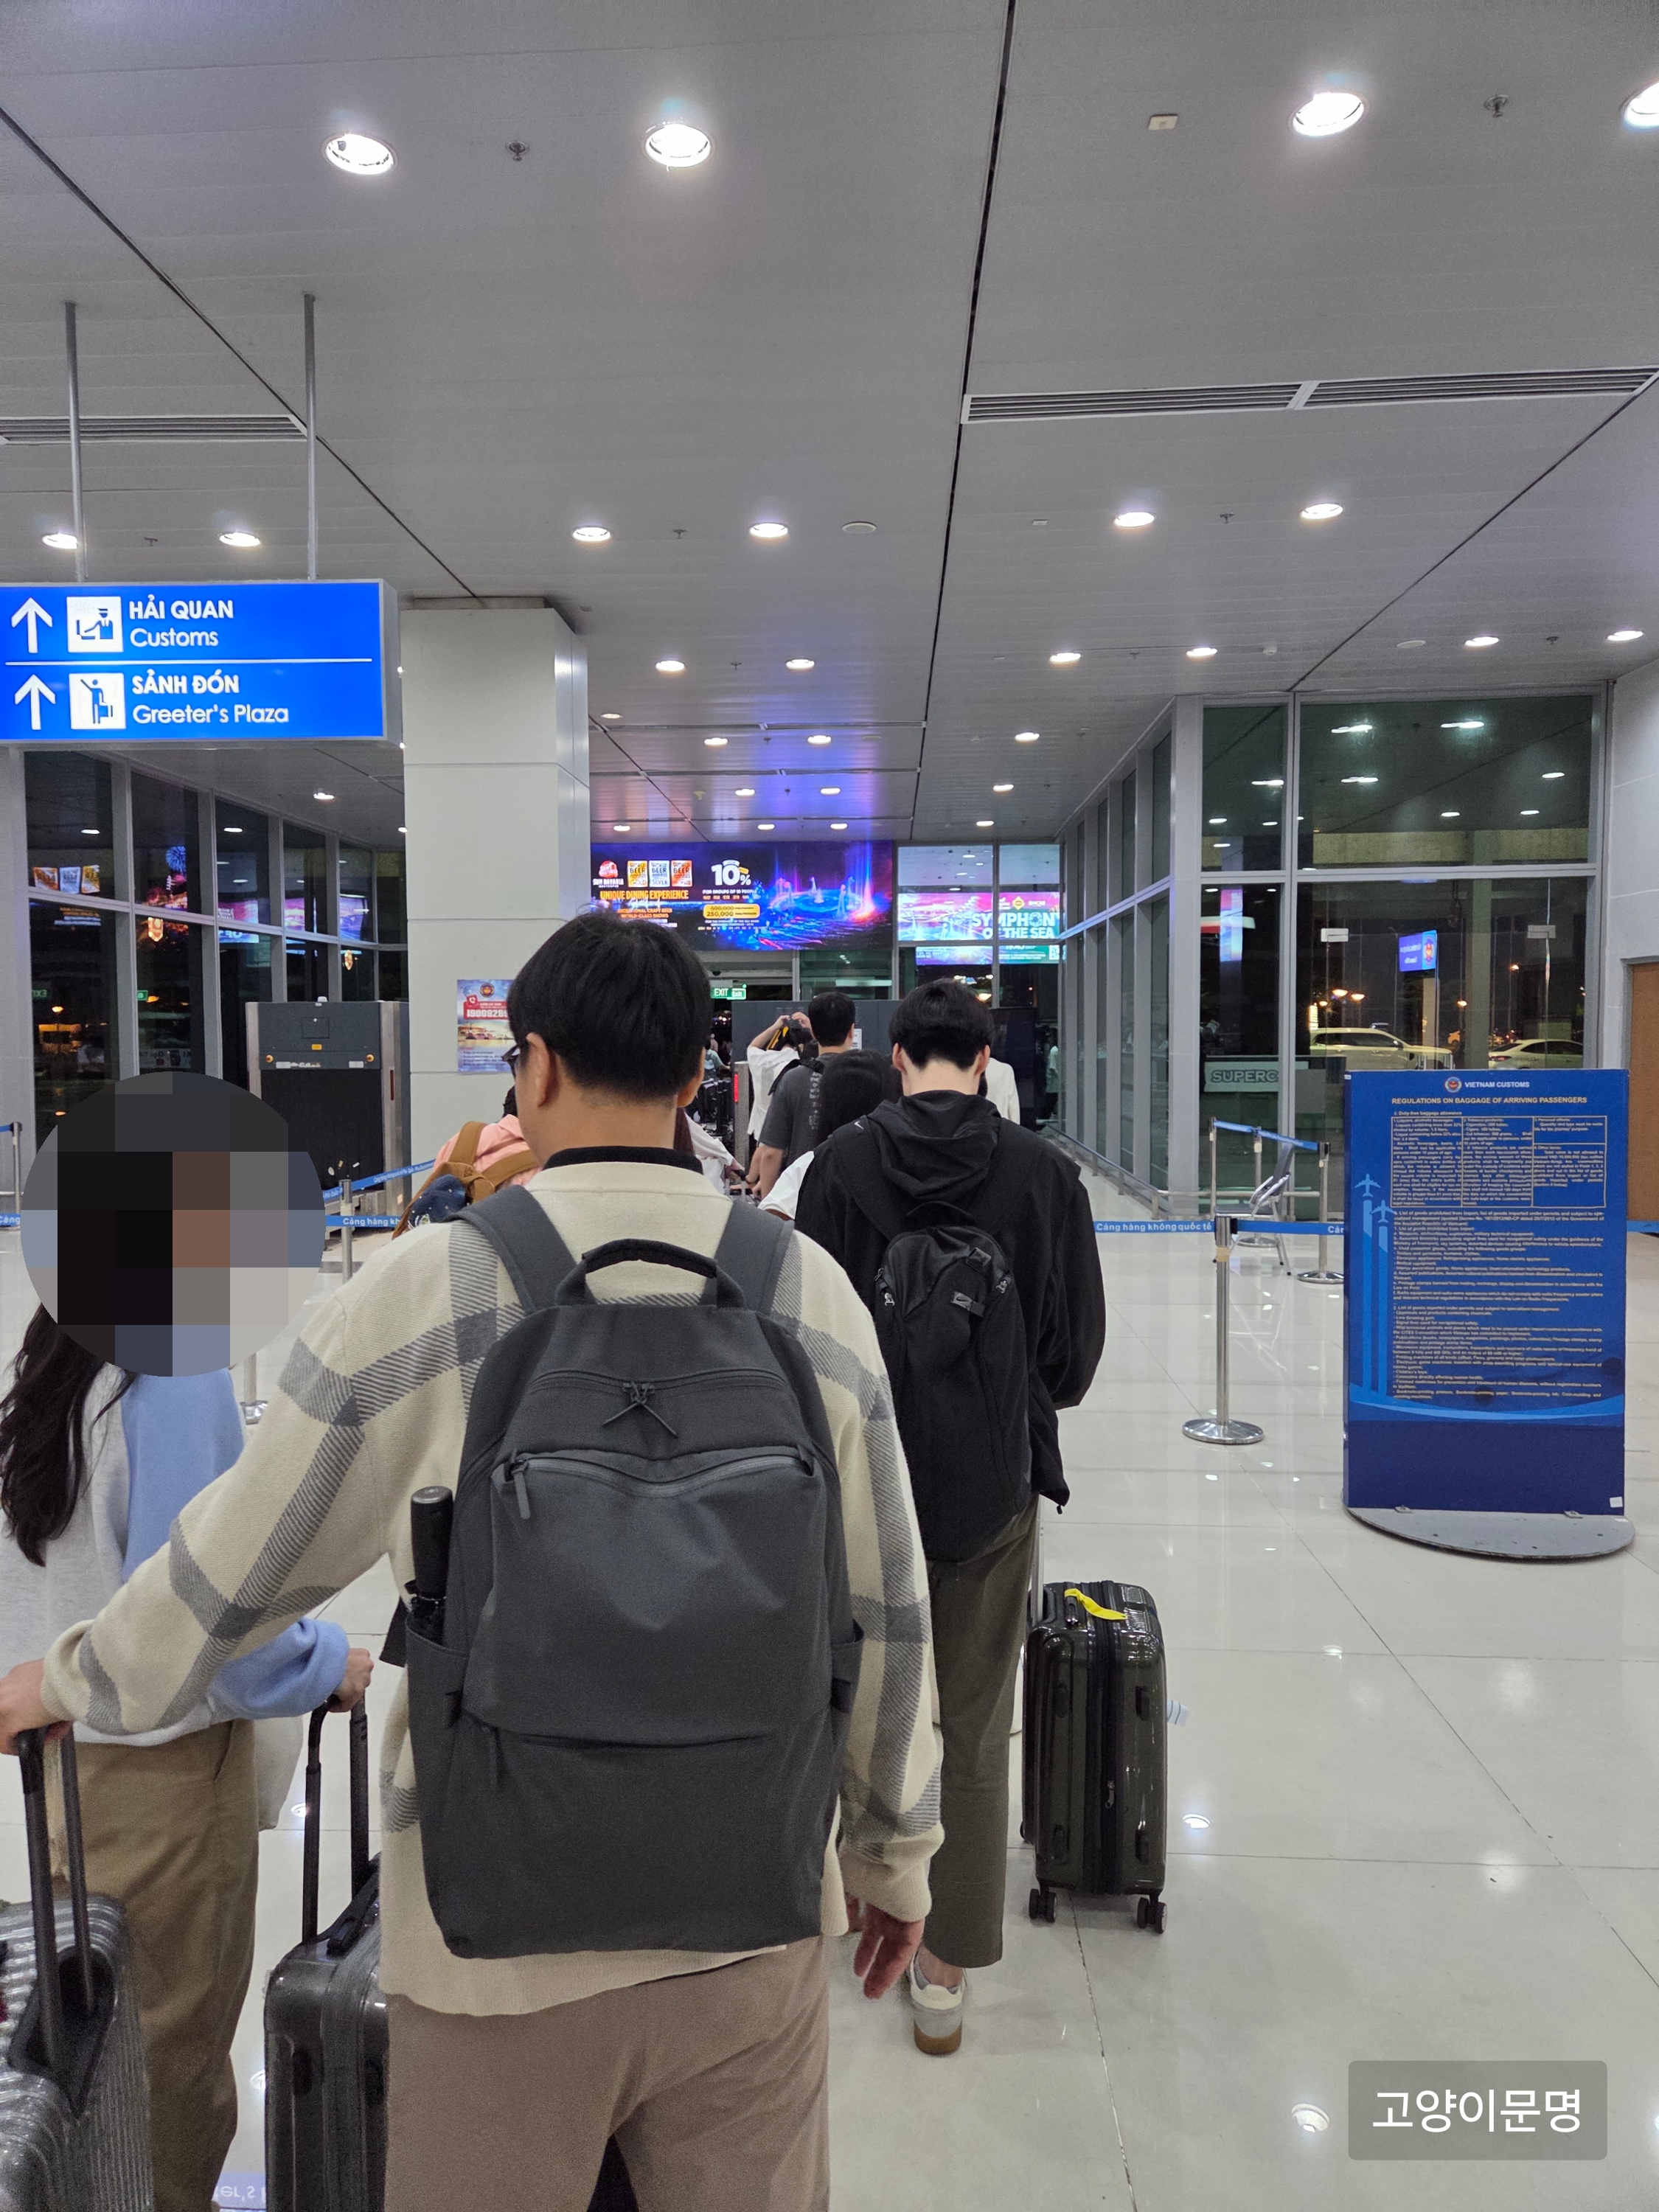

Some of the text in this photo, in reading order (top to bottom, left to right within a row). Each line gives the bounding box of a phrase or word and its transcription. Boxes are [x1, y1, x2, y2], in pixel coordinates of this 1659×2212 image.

[129, 594, 234, 620] HẢI QUAN
[130, 627, 219, 647] Customs
[132, 669, 240, 694] SẢNH ĐÓN
[133, 704, 289, 724] Greeter's Plaza
[600, 890, 689, 900] UNIQUE DINING EXPERIENCE
[1005, 927, 1028, 938] THE
[1030, 927, 1055, 938] SEA
[714, 988, 729, 996] EXIT
[343, 1217, 365, 1226] Cảng
[367, 1217, 387, 1226] hàng
[1096, 1222, 1212, 1232] Cảng hàng không quốc tế
